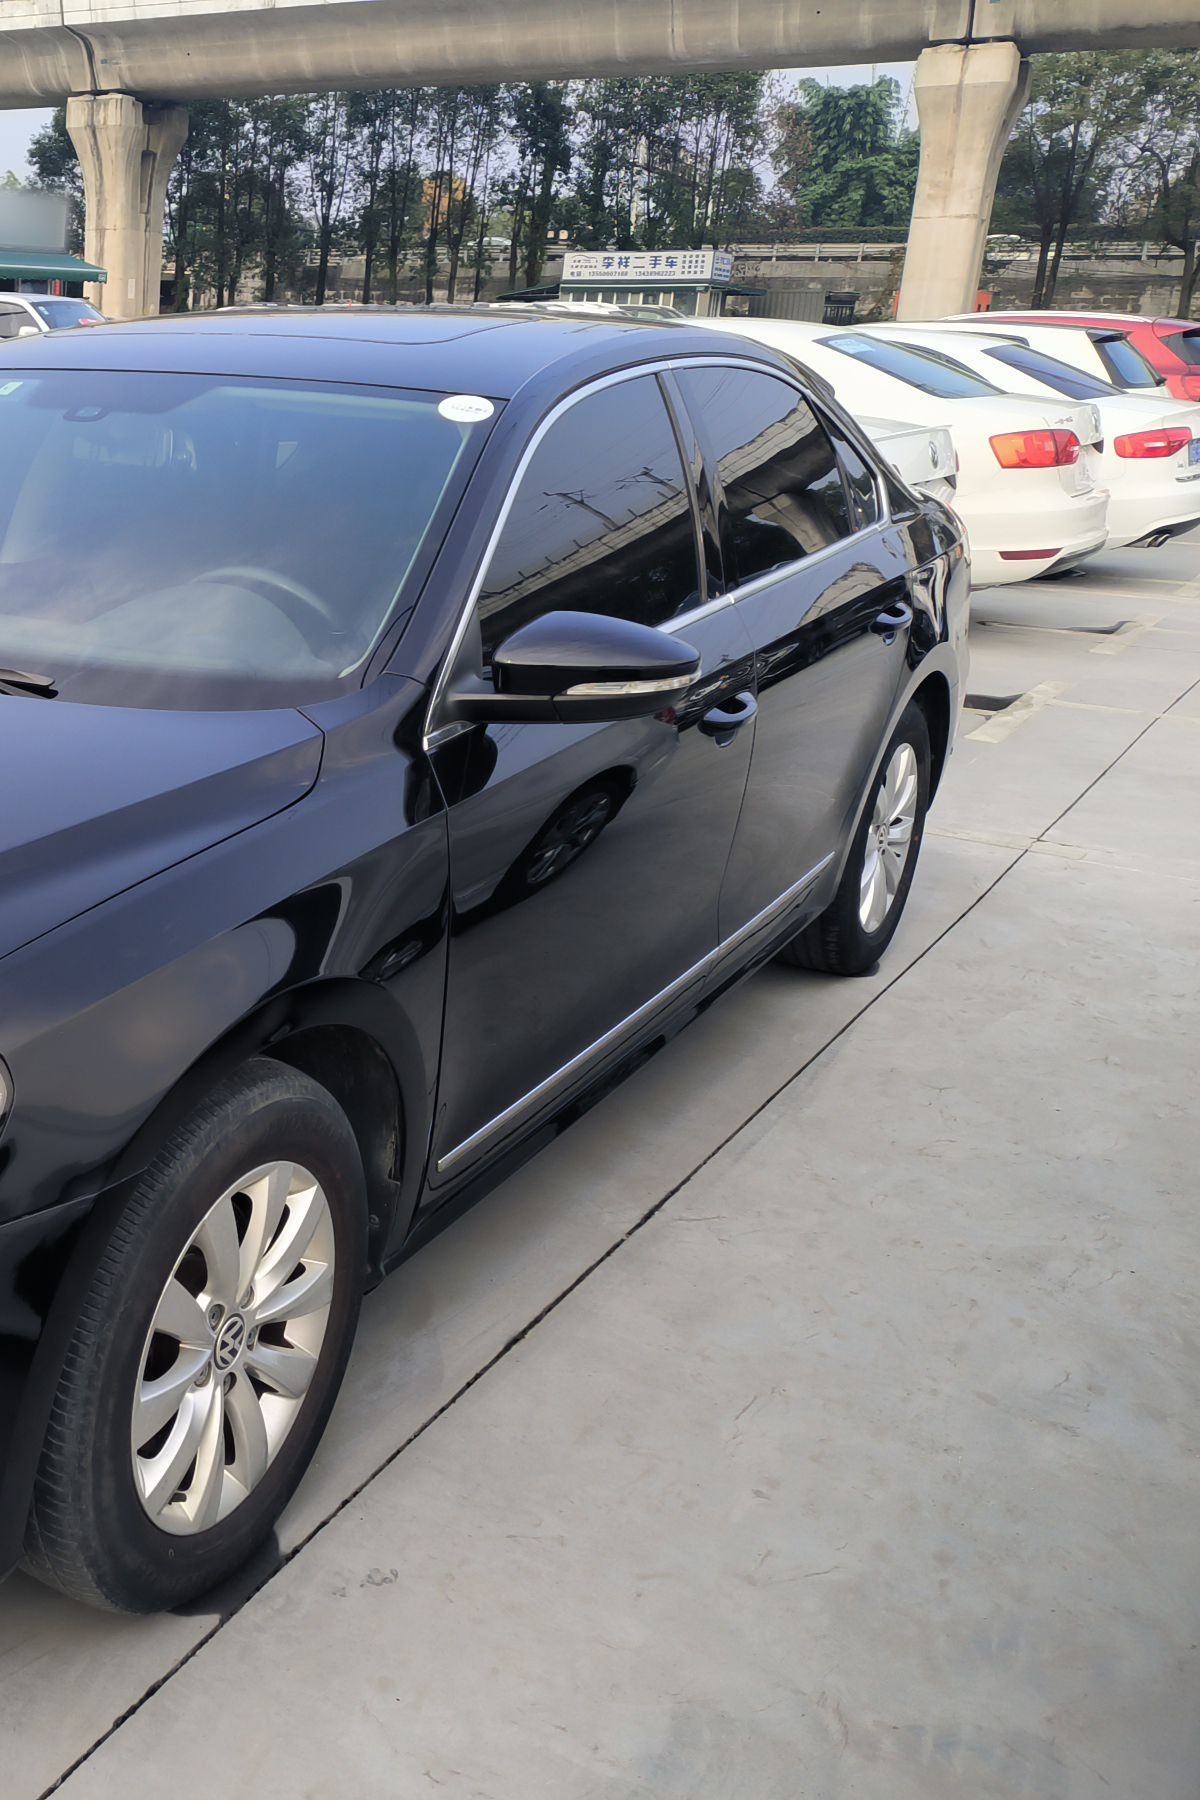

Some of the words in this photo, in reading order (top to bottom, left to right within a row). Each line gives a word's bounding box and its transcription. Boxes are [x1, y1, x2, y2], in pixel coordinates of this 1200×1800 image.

[602, 256, 679, 269] 李祥二手车
